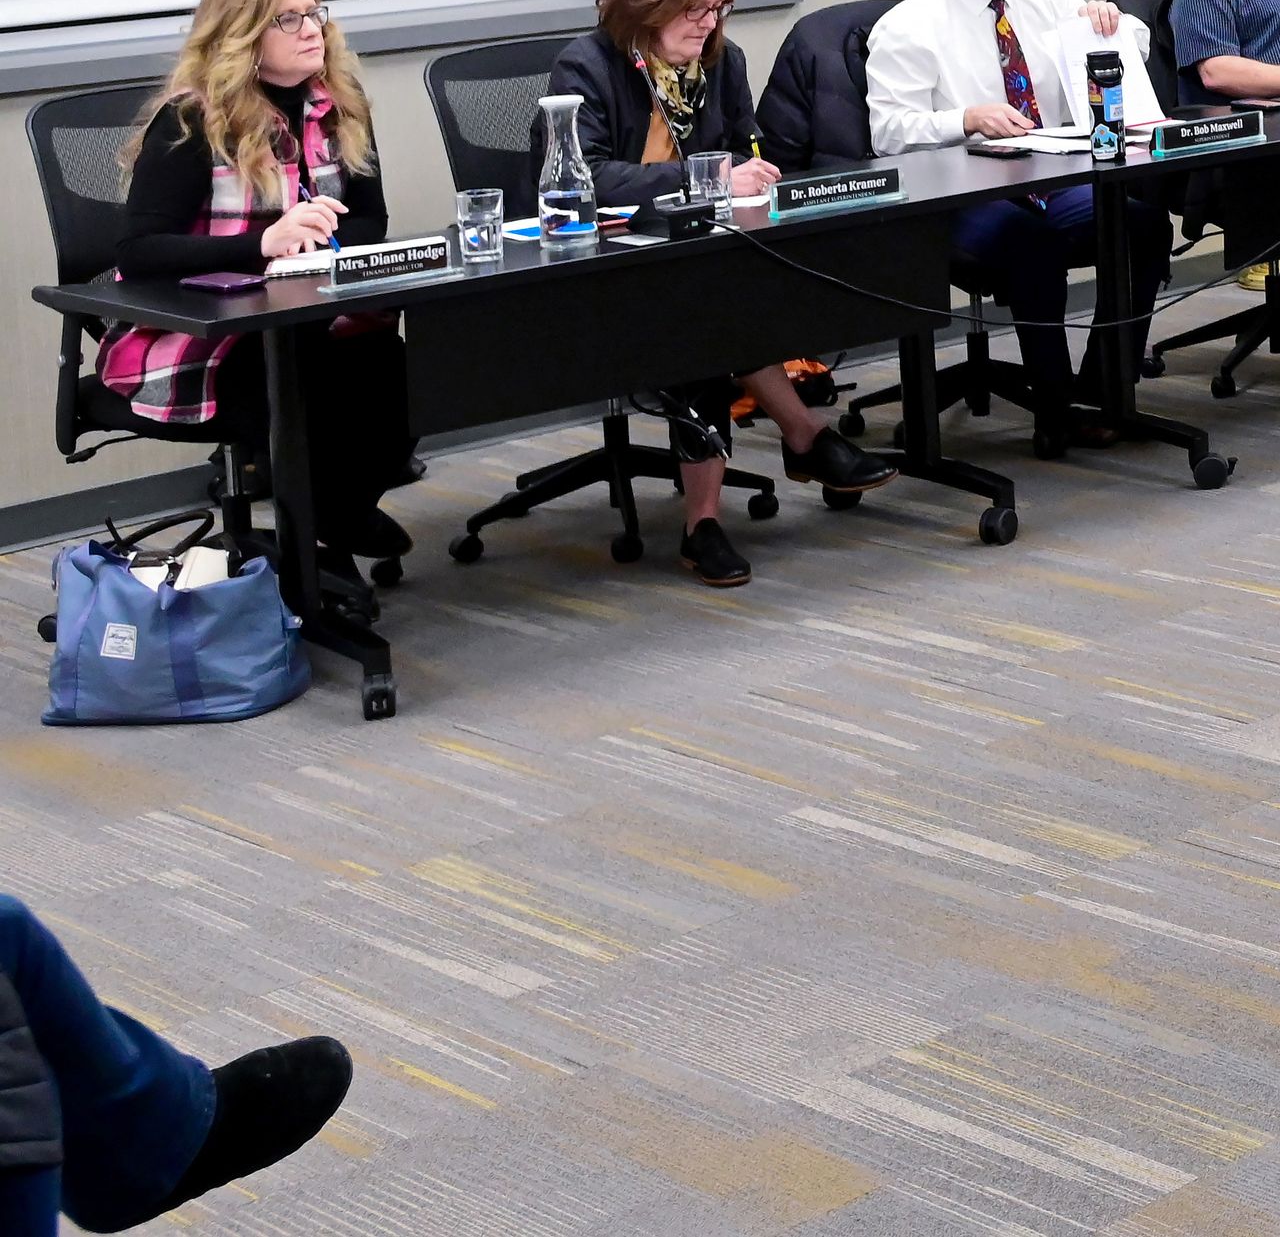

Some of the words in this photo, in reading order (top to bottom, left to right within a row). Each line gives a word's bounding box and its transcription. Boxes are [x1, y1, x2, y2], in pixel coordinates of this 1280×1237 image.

[1180, 127, 1194, 138] Dr.
[1194, 124, 1209, 136] Bob
[1210, 118, 1243, 133] Maxwell
[790, 188, 807, 200] Dr.
[807, 183, 848, 197] Roberta
[848, 177, 887, 191] Kramer
[338, 258, 368, 271] Mrs.
[370, 252, 405, 267] Diane
[407, 245, 445, 261] Hodge
[362, 267, 390, 277] FINANCE
[391, 262, 424, 274] DIRECTOR
